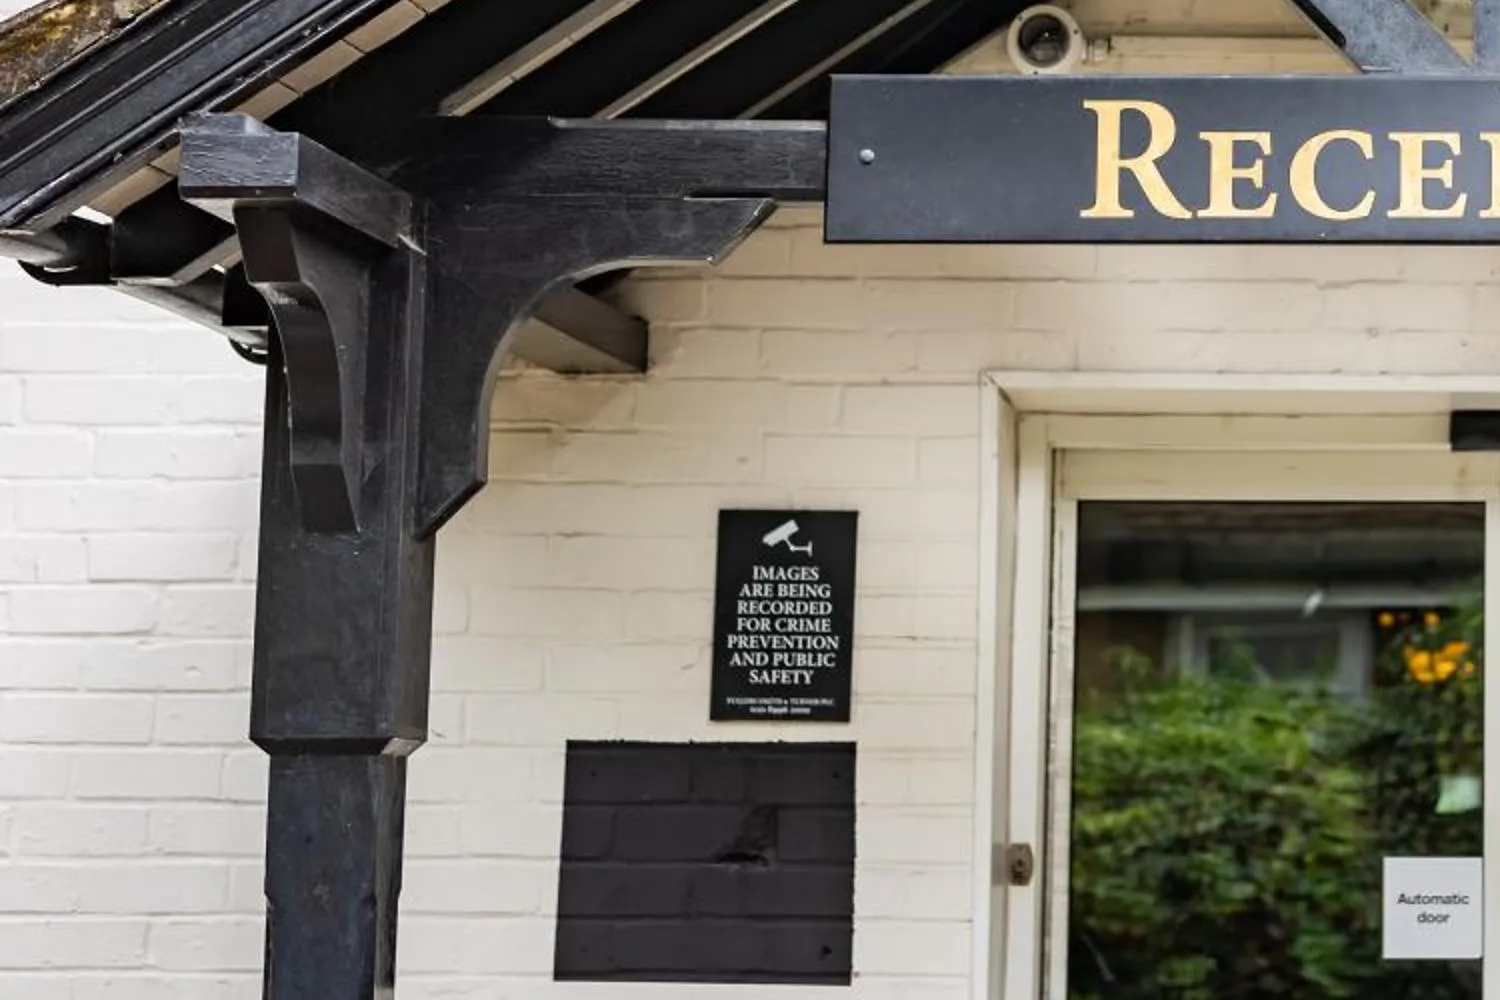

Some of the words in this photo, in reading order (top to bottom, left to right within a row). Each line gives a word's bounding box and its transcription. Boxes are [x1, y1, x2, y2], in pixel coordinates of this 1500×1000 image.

[752, 565, 820, 581] IMAGES
[739, 583, 774, 598] ARE
[777, 583, 831, 599] BEING
[737, 600, 833, 615] RECORDED
[737, 617, 771, 632] FOR
[775, 617, 831, 633] CRIME
[727, 634, 840, 650] PREVENTION
[729, 652, 769, 667] AND
[773, 652, 837, 668] PUBLIC
[749, 669, 814, 685] SAFETY
[1397, 892, 1470, 906] Automatic
[1417, 910, 1452, 924] door
